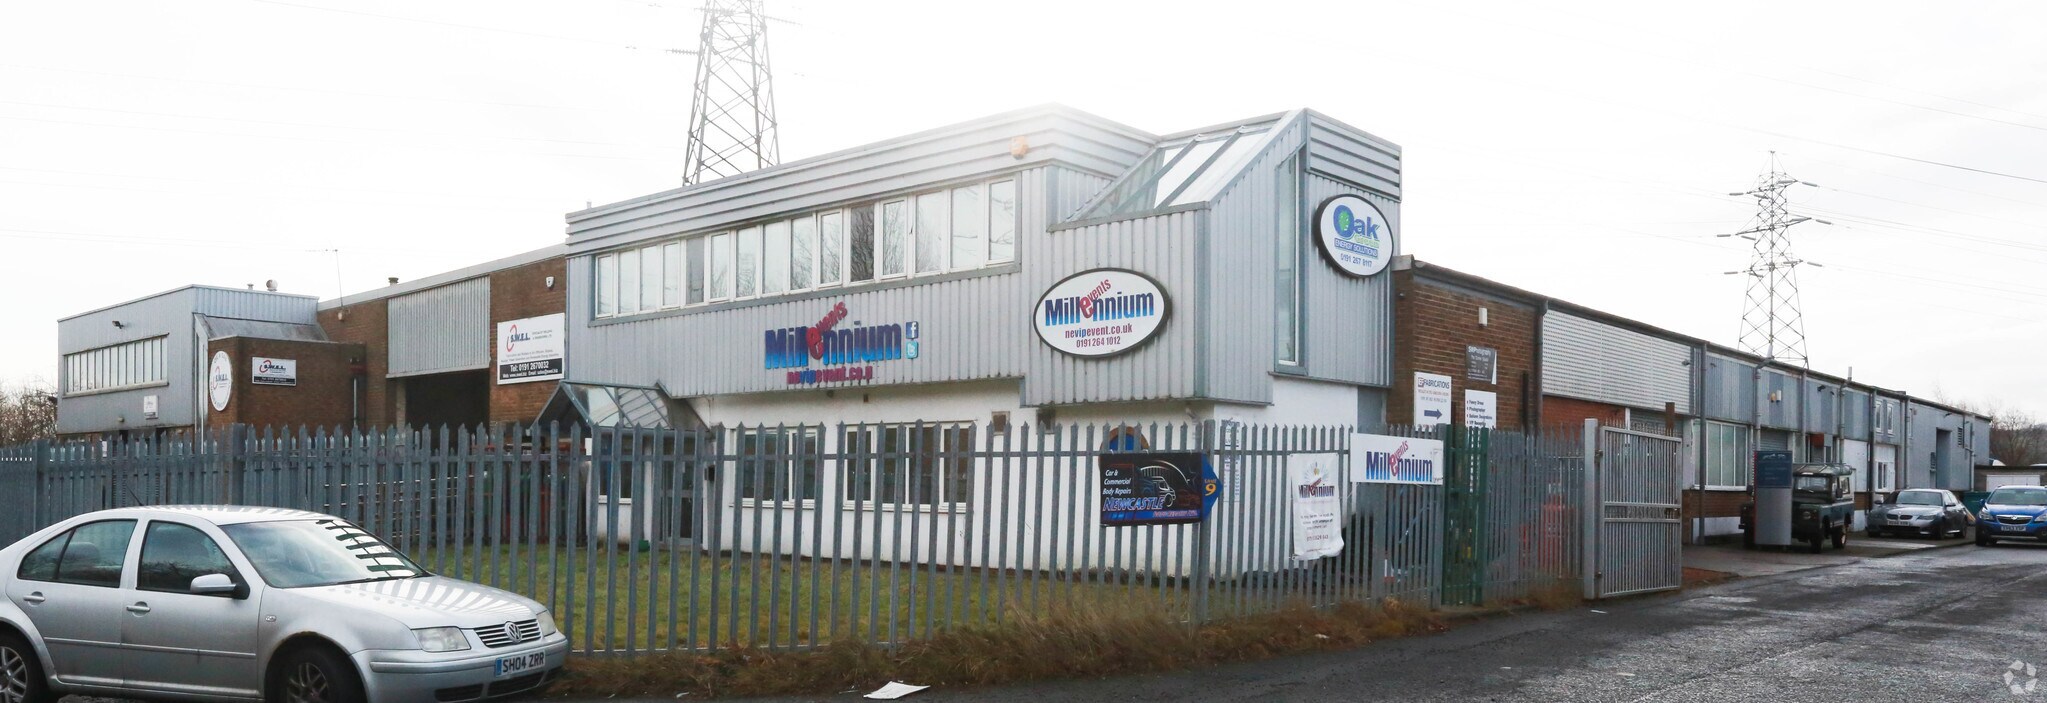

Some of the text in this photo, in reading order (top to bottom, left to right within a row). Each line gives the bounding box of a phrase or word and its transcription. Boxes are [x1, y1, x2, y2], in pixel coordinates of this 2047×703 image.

[1045, 291, 1154, 327] Millennium
[1065, 323, 1133, 339] nevipevent.co.uk
[764, 320, 902, 370] Millennium
[1076, 336, 1121, 348] 0191 264 1012
[510, 364, 519, 373] Tel:
[519, 363, 530, 372] 0191
[1366, 451, 1433, 482] Millennium
[1102, 488, 1132, 496] Body Repairs
[1205, 484, 1217, 496] 9
[1102, 497, 1165, 511] NEWCASTLE
[502, 652, 545, 673] SH04 ZRR
